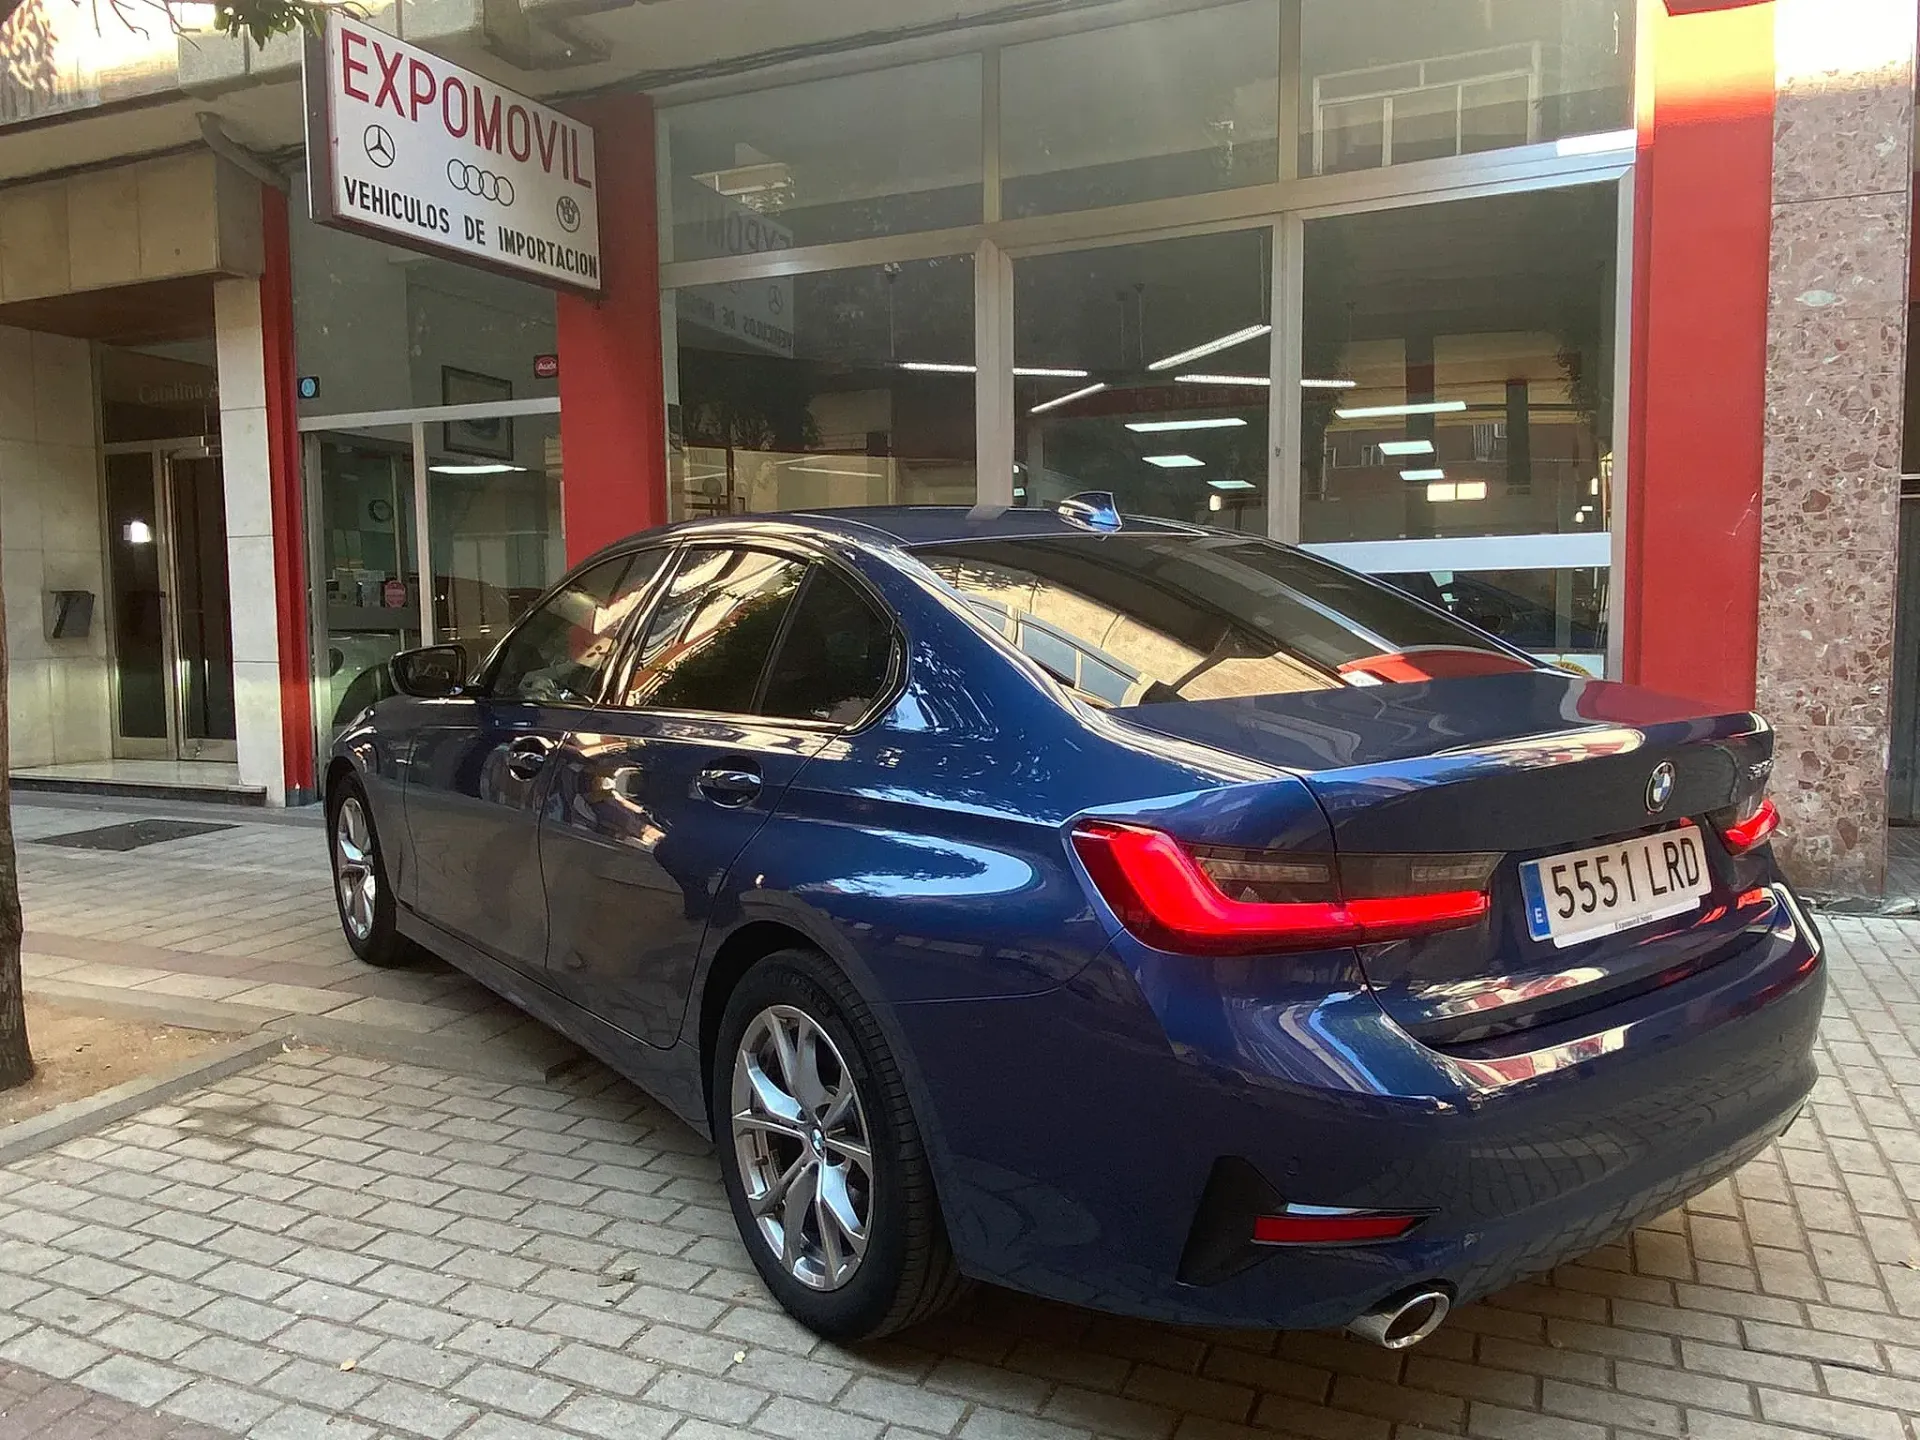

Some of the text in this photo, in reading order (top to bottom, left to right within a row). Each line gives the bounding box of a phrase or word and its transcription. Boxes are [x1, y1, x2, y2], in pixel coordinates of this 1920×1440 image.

[341, 28, 592, 189] EXPOMOVIL
[344, 176, 598, 279] VEHICULOS DE IMPORTACION
[1534, 907, 1545, 924] E
[1551, 837, 1701, 919] 5551 LRD
